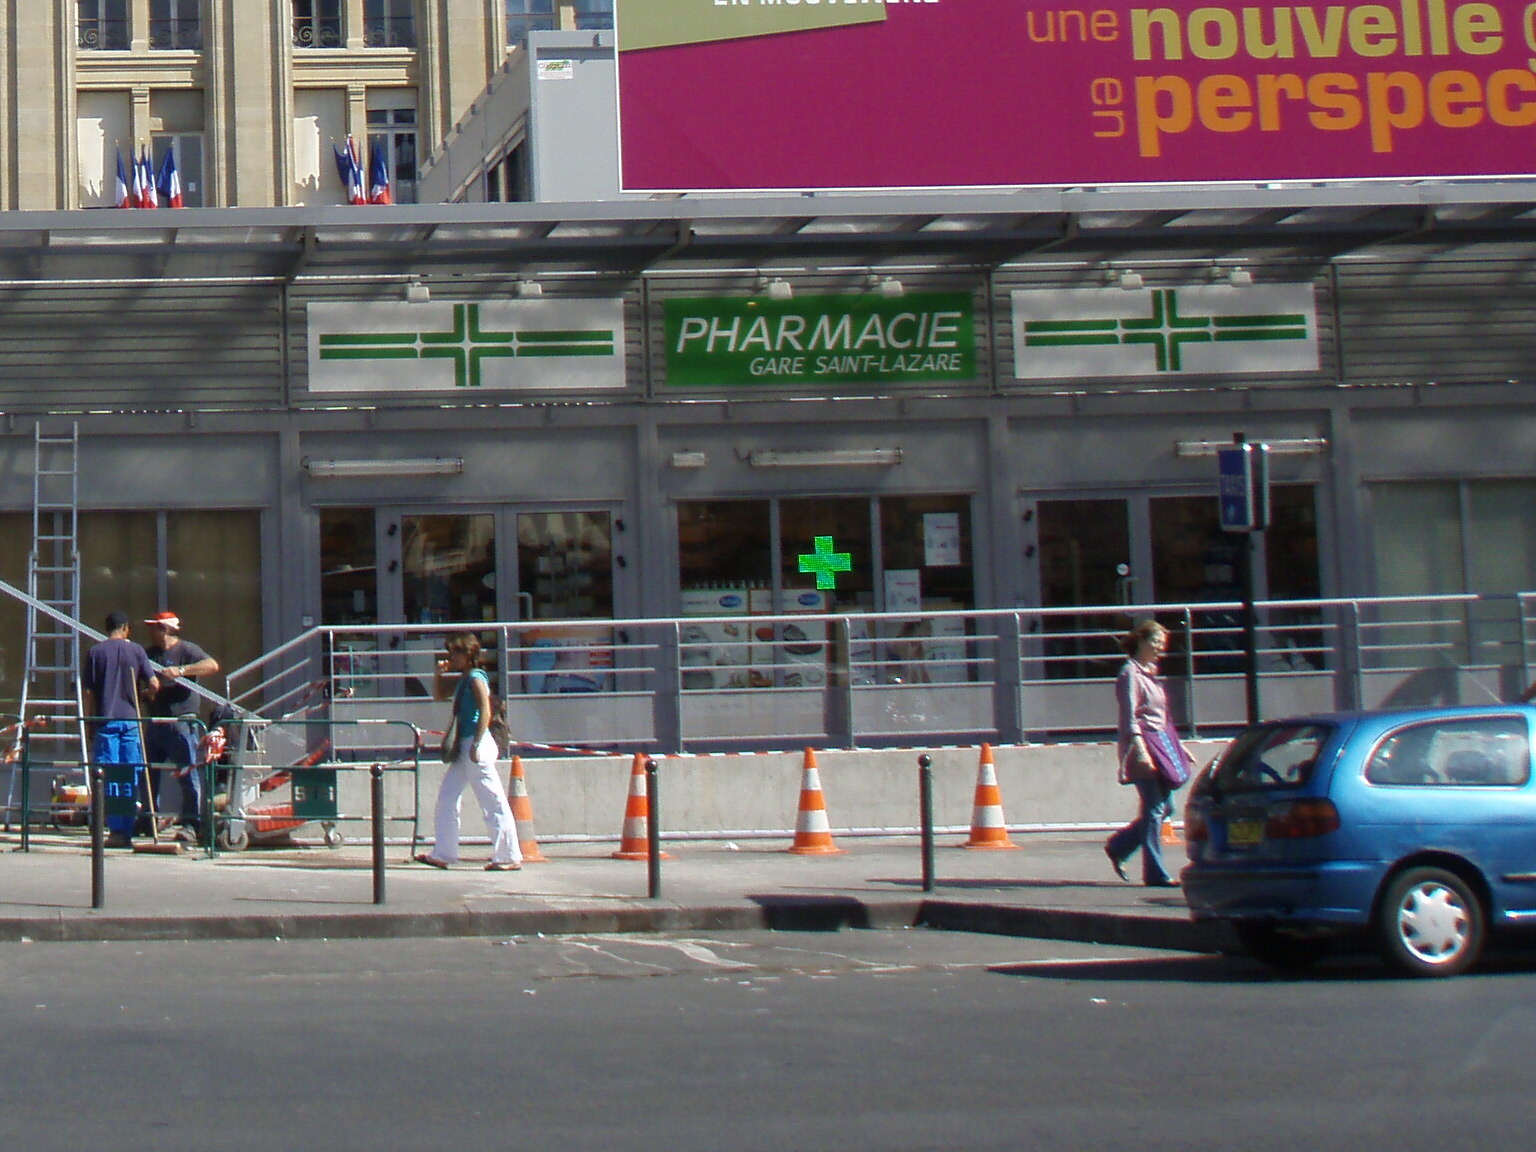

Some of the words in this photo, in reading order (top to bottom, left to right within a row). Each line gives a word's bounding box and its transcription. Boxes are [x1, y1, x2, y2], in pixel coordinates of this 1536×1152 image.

[1026, 8, 1120, 42] une
[1090, 77, 1124, 138] en
[1134, 69, 1536, 158] perspec
[676, 311, 962, 353] PHARMACIE
[750, 357, 805, 376] GARE
[814, 353, 962, 374] SAINT-LAZARE
